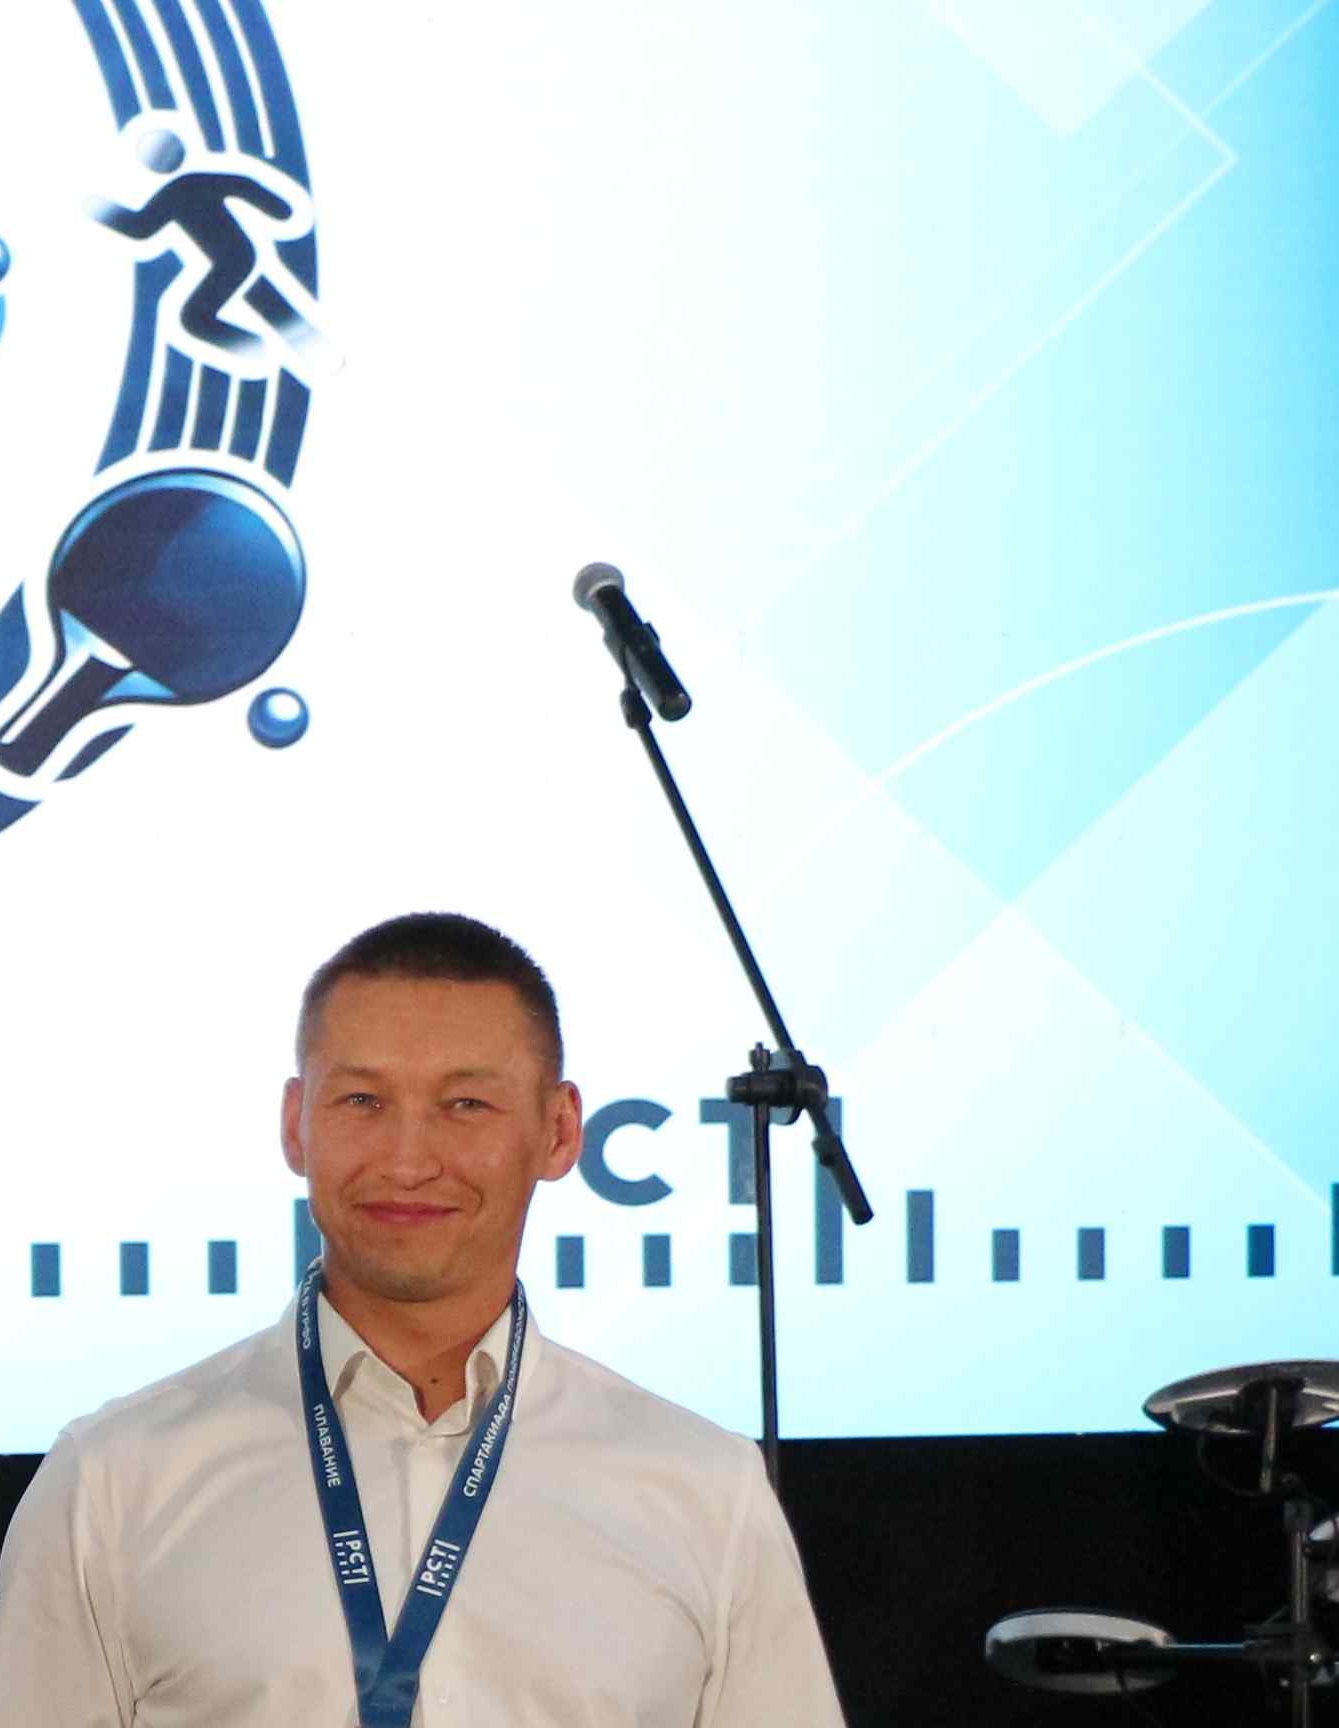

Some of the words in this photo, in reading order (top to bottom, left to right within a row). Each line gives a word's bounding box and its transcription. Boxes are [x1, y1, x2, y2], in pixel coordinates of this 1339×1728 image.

[578, 1098, 772, 1207] СТ
[313, 1403, 342, 1488] ПЛАВАНИЕ
[463, 1393, 512, 1498] СПАРТАКИАДА
